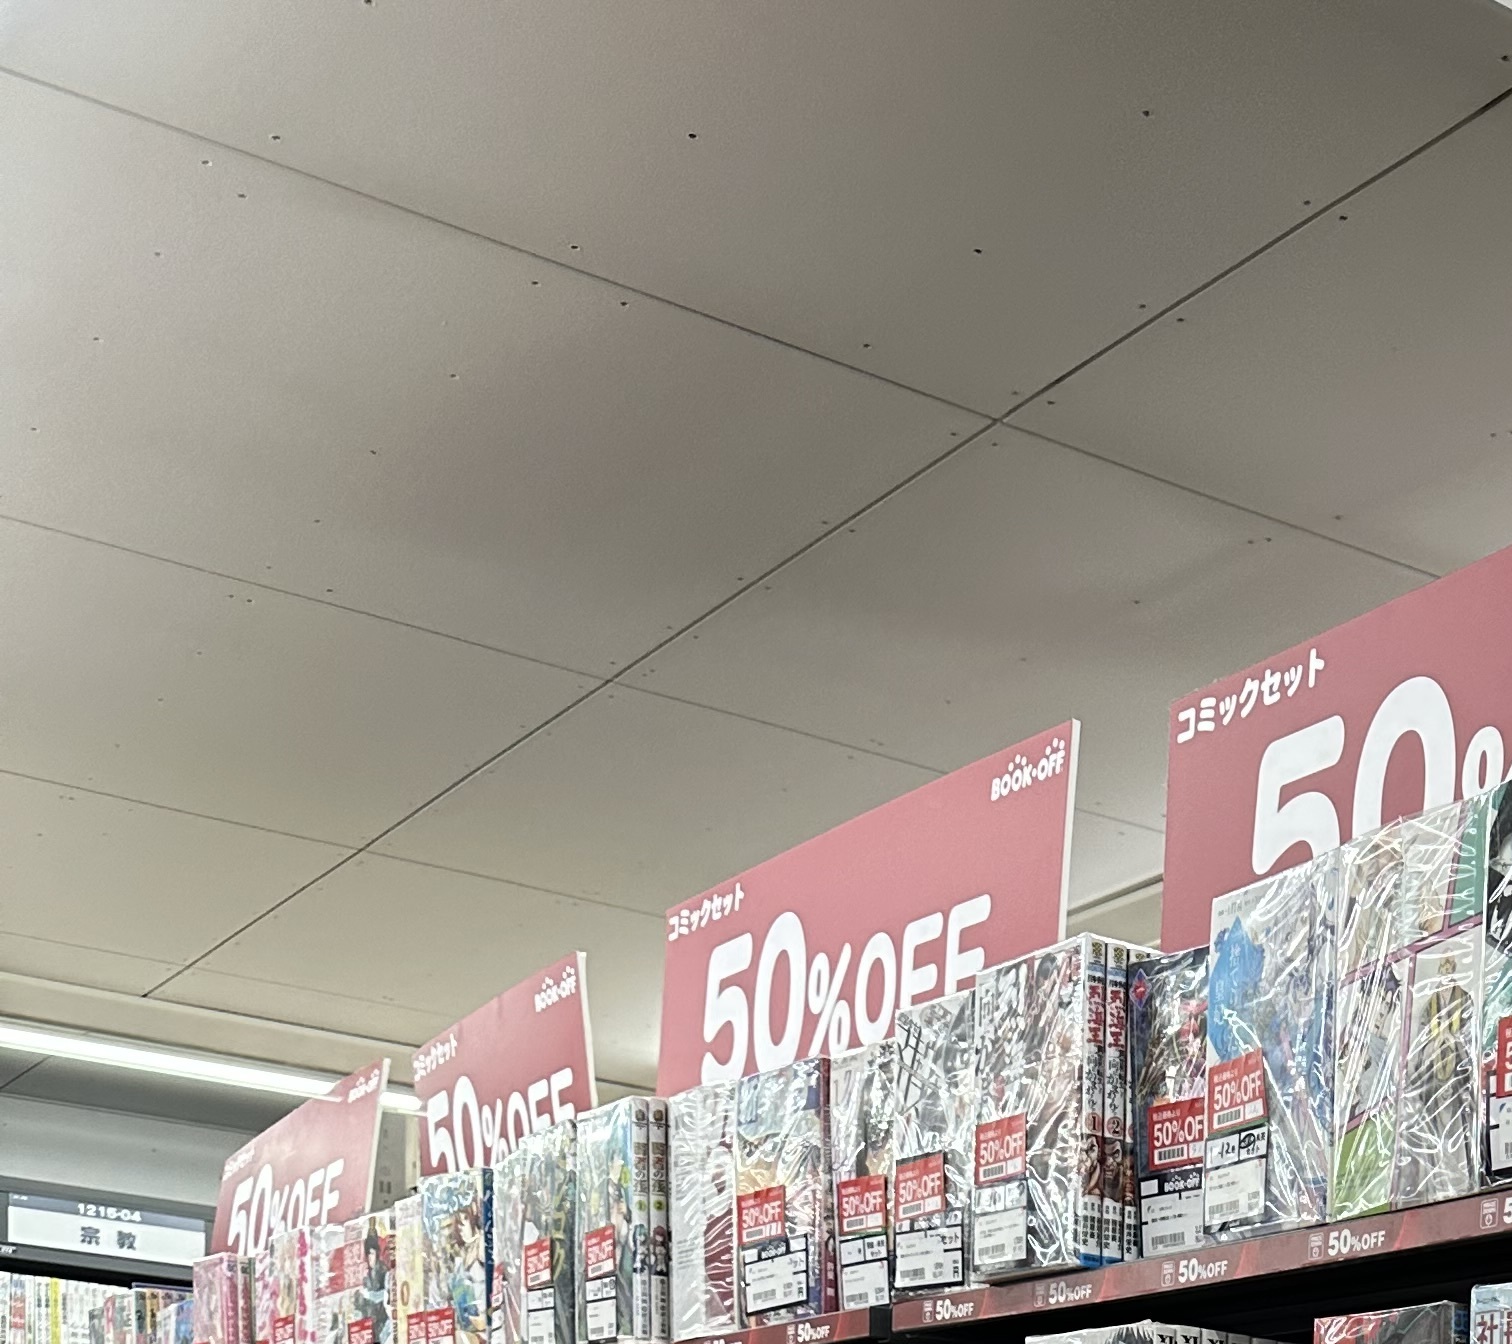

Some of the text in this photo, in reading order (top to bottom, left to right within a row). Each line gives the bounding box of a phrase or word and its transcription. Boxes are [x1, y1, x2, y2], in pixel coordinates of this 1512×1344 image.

[1176, 648, 1326, 745] コミックセット
[667, 882, 745, 942] コミックセット
[701, 893, 992, 1085] 50%OFF
[413, 1033, 459, 1081] コミックセット
[79, 1225, 138, 1251] 宗教
